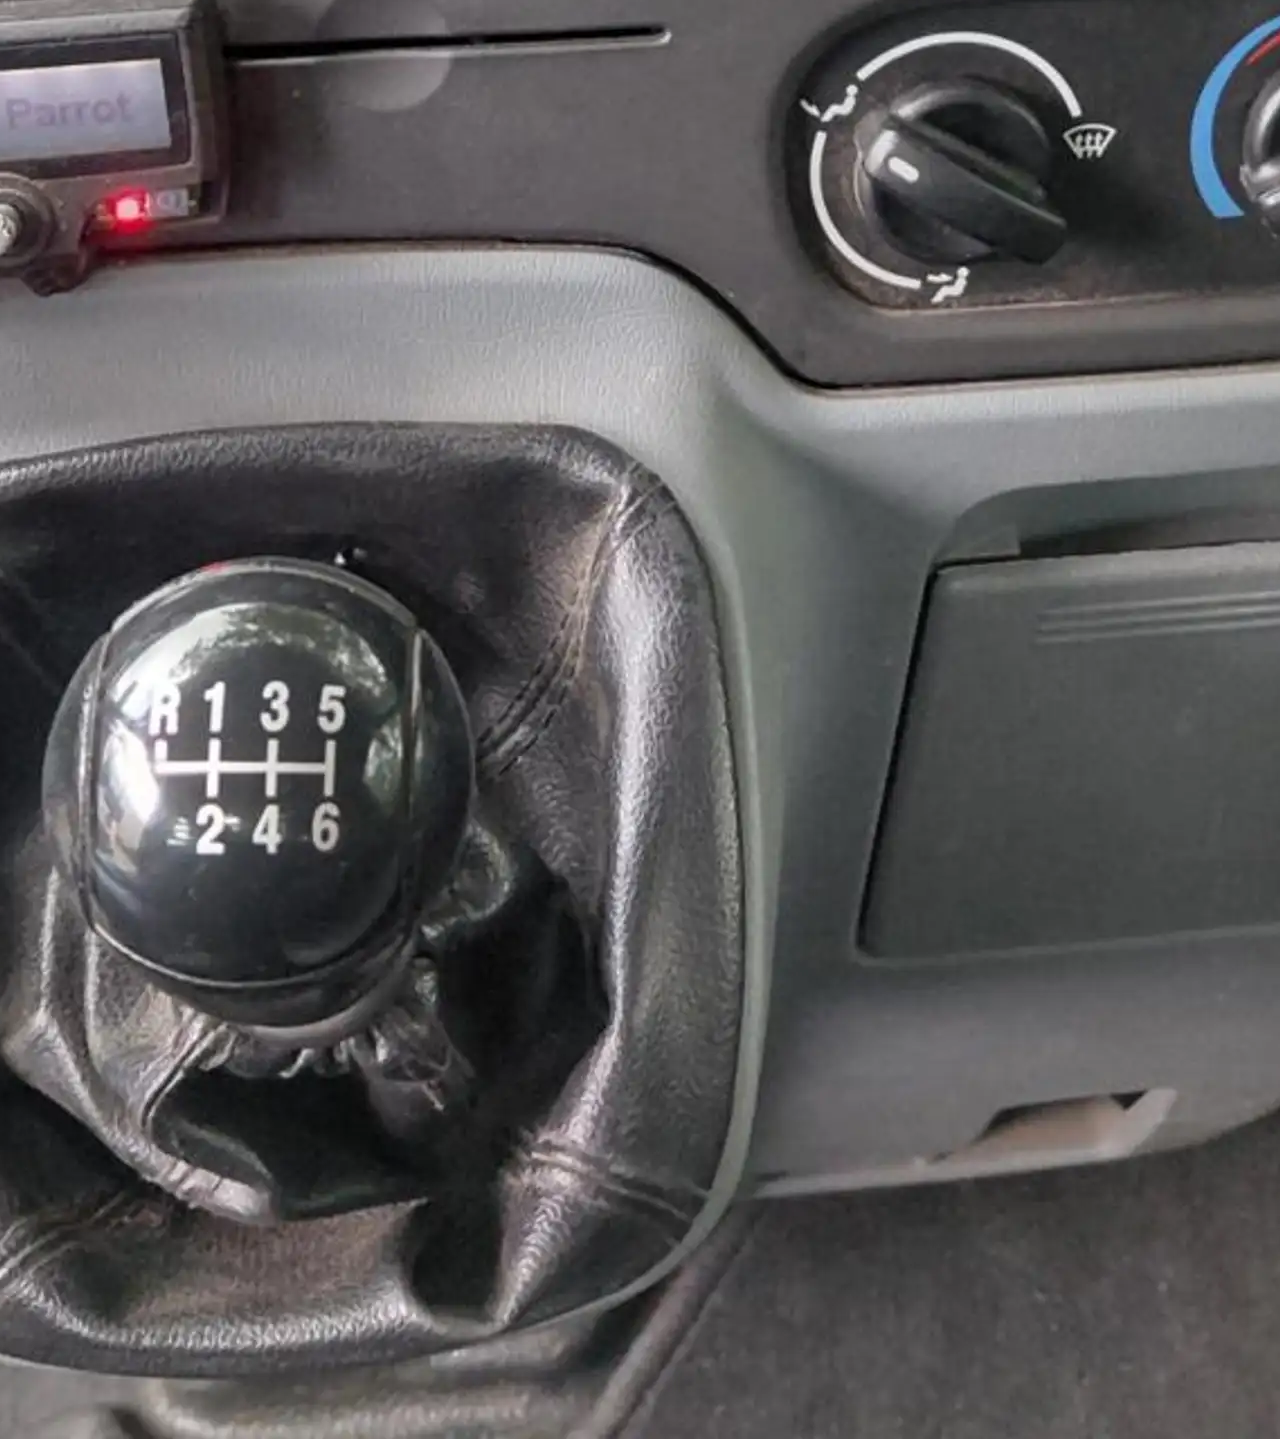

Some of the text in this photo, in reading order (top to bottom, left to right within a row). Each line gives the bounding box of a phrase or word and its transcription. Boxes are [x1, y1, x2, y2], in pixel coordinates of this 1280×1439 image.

[4, 90, 135, 131] Parrot
[148, 679, 347, 736] R 1 3 5
[195, 803, 341, 856] 2 4 6
